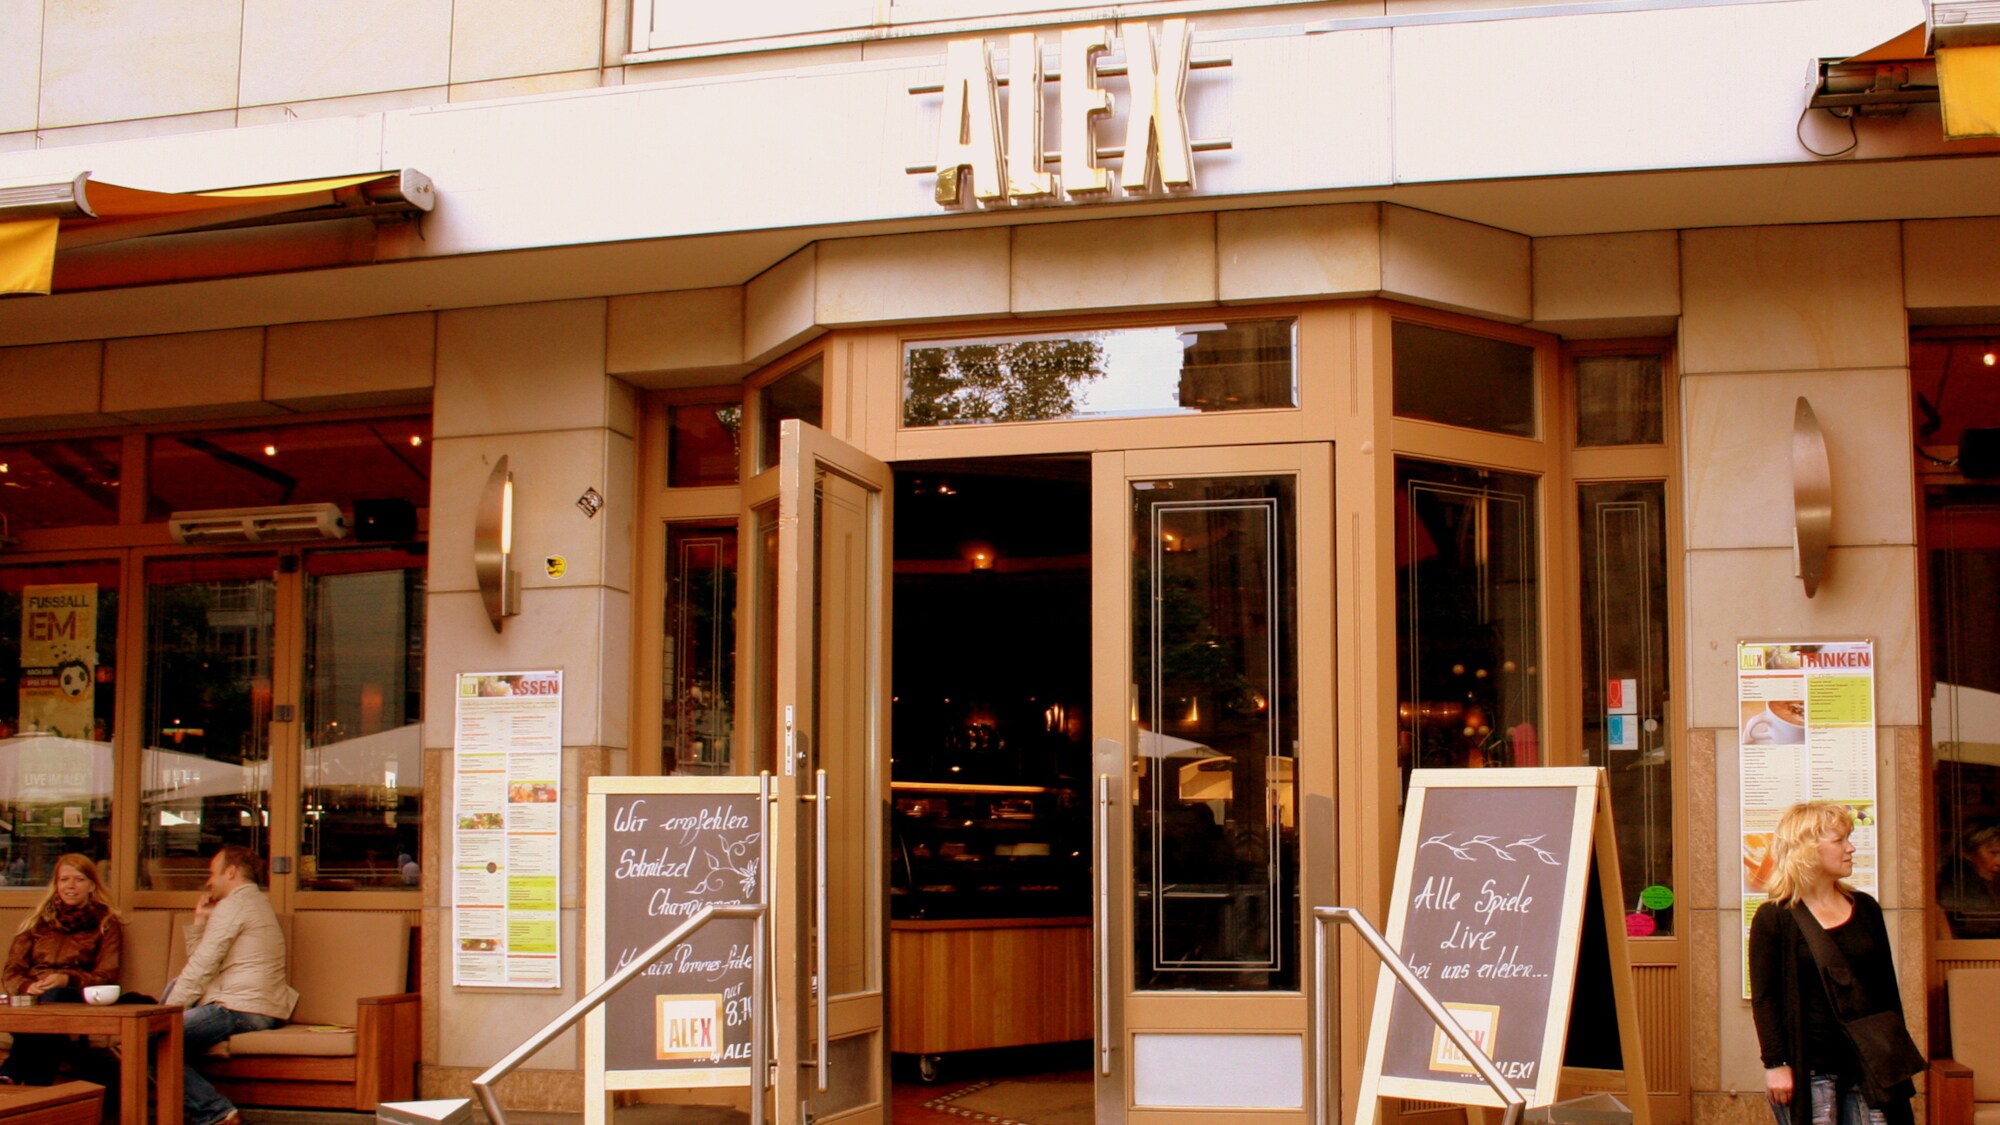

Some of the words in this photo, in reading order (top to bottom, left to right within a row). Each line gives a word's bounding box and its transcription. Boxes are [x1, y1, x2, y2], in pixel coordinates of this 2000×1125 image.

[935, 18, 1196, 207] ALEX
[29, 595, 89, 609] FUSSBALL
[28, 611, 76, 641] EM
[1798, 652, 1870, 668] TRINKEN
[512, 680, 559, 696] ESSEN
[25, 773, 47, 786] LIVE
[613, 800, 648, 832] Wir
[659, 805, 750, 847] empfehlen
[615, 846, 697, 879] Schnitzel
[648, 888, 741, 919] Champi
[1414, 876, 1461, 910] Alle
[1474, 874, 1533, 925] Spiele
[1440, 921, 1497, 950] Live
[1441, 963, 1471, 979] uns
[723, 982, 744, 1001] nur
[669, 1018, 712, 1048] ALEX
[723, 1042, 752, 1060] ALE
